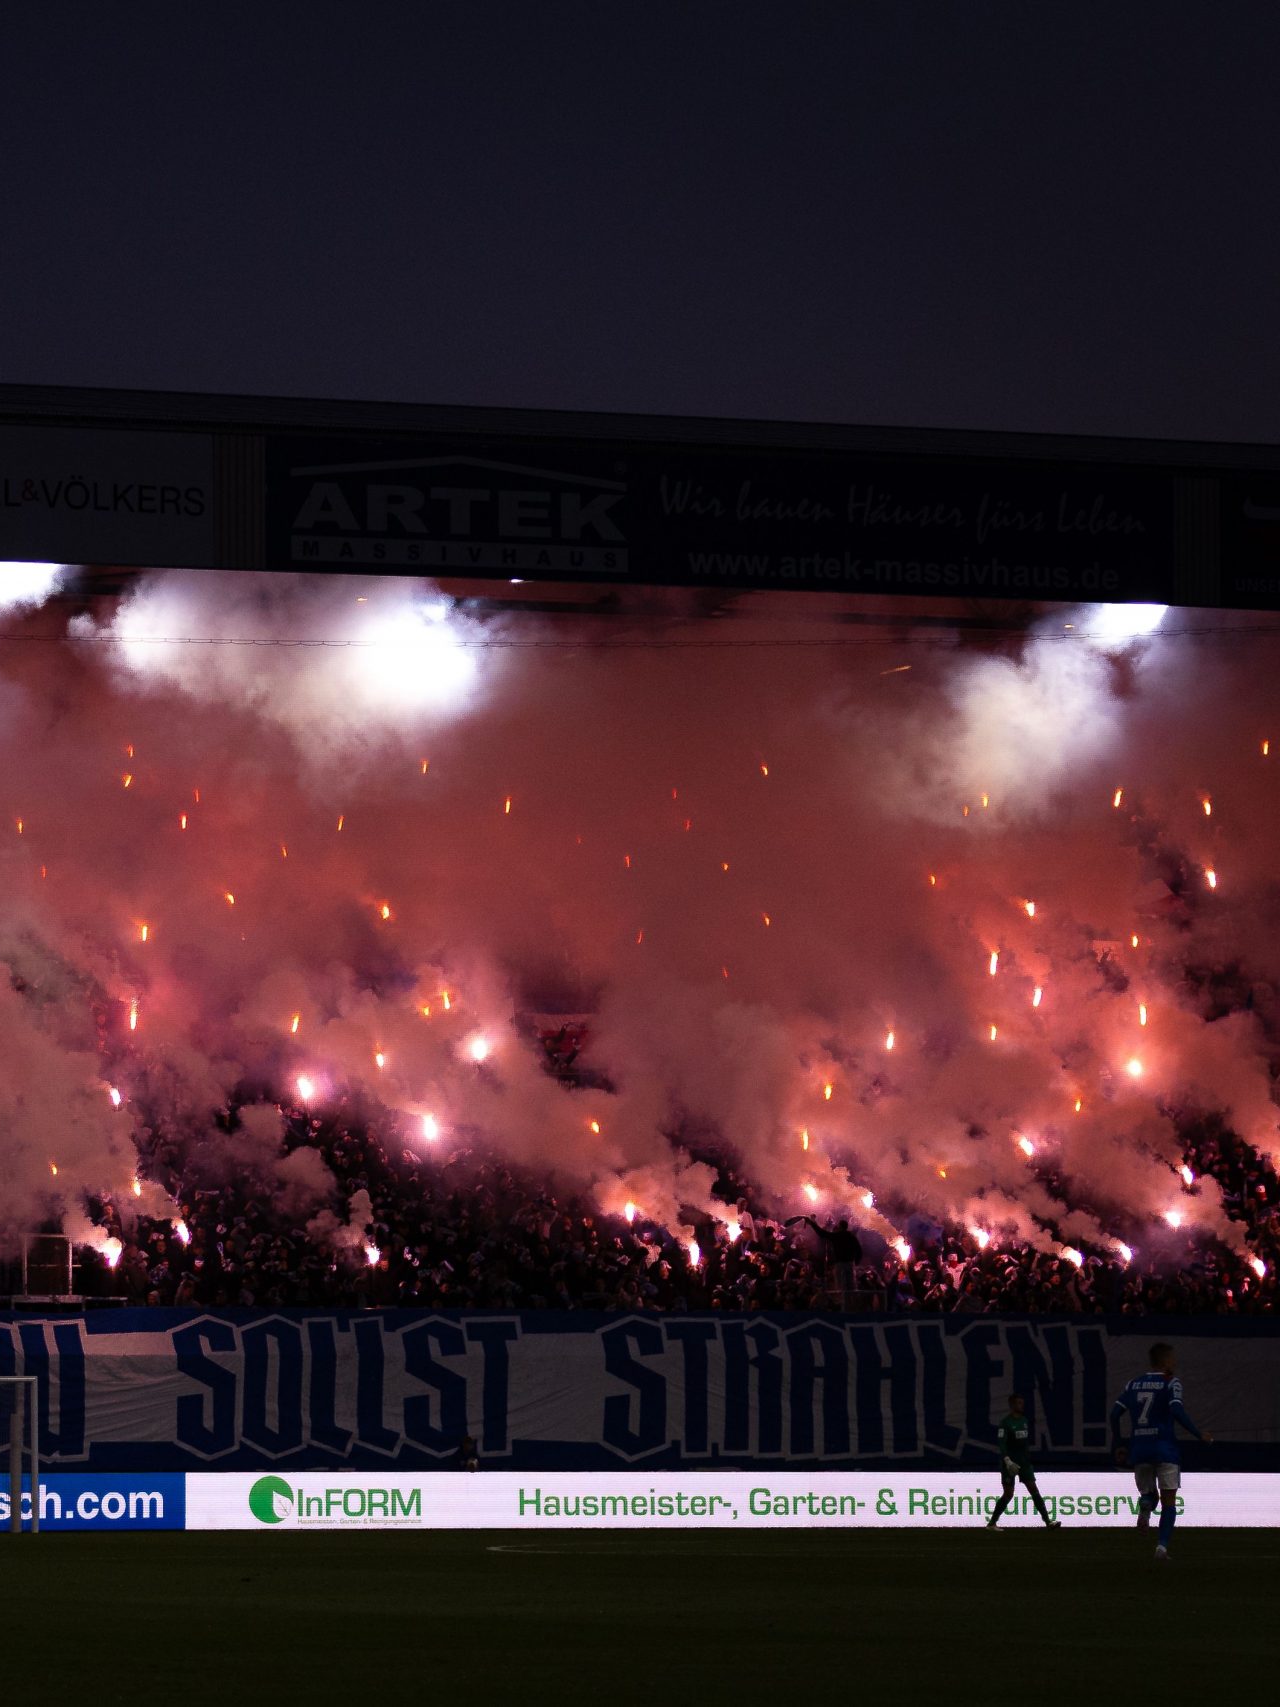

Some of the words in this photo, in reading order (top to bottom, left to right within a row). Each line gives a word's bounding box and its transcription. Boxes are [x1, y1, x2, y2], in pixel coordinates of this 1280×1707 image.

[290, 481, 628, 543] ARTEK
[658, 472, 728, 518] Wir
[735, 479, 838, 523] bauen
[846, 482, 969, 529] Häuser
[975, 491, 1047, 545] fürs
[1055, 489, 1148, 537] Leben
[302, 540, 618, 569] MASSIVHAUS
[688, 550, 1120, 591] www.artek-massivhaus.de
[167, 1313, 521, 1461] SOLLST
[595, 1314, 1109, 1463] STRAHLEN!
[1136, 1391, 1155, 1425] 7
[297, 1488, 422, 1517] InFORM
[519, 1487, 738, 1520] Hausmeister-,
[748, 1487, 867, 1517] Garten-
[875, 1487, 900, 1516] &
